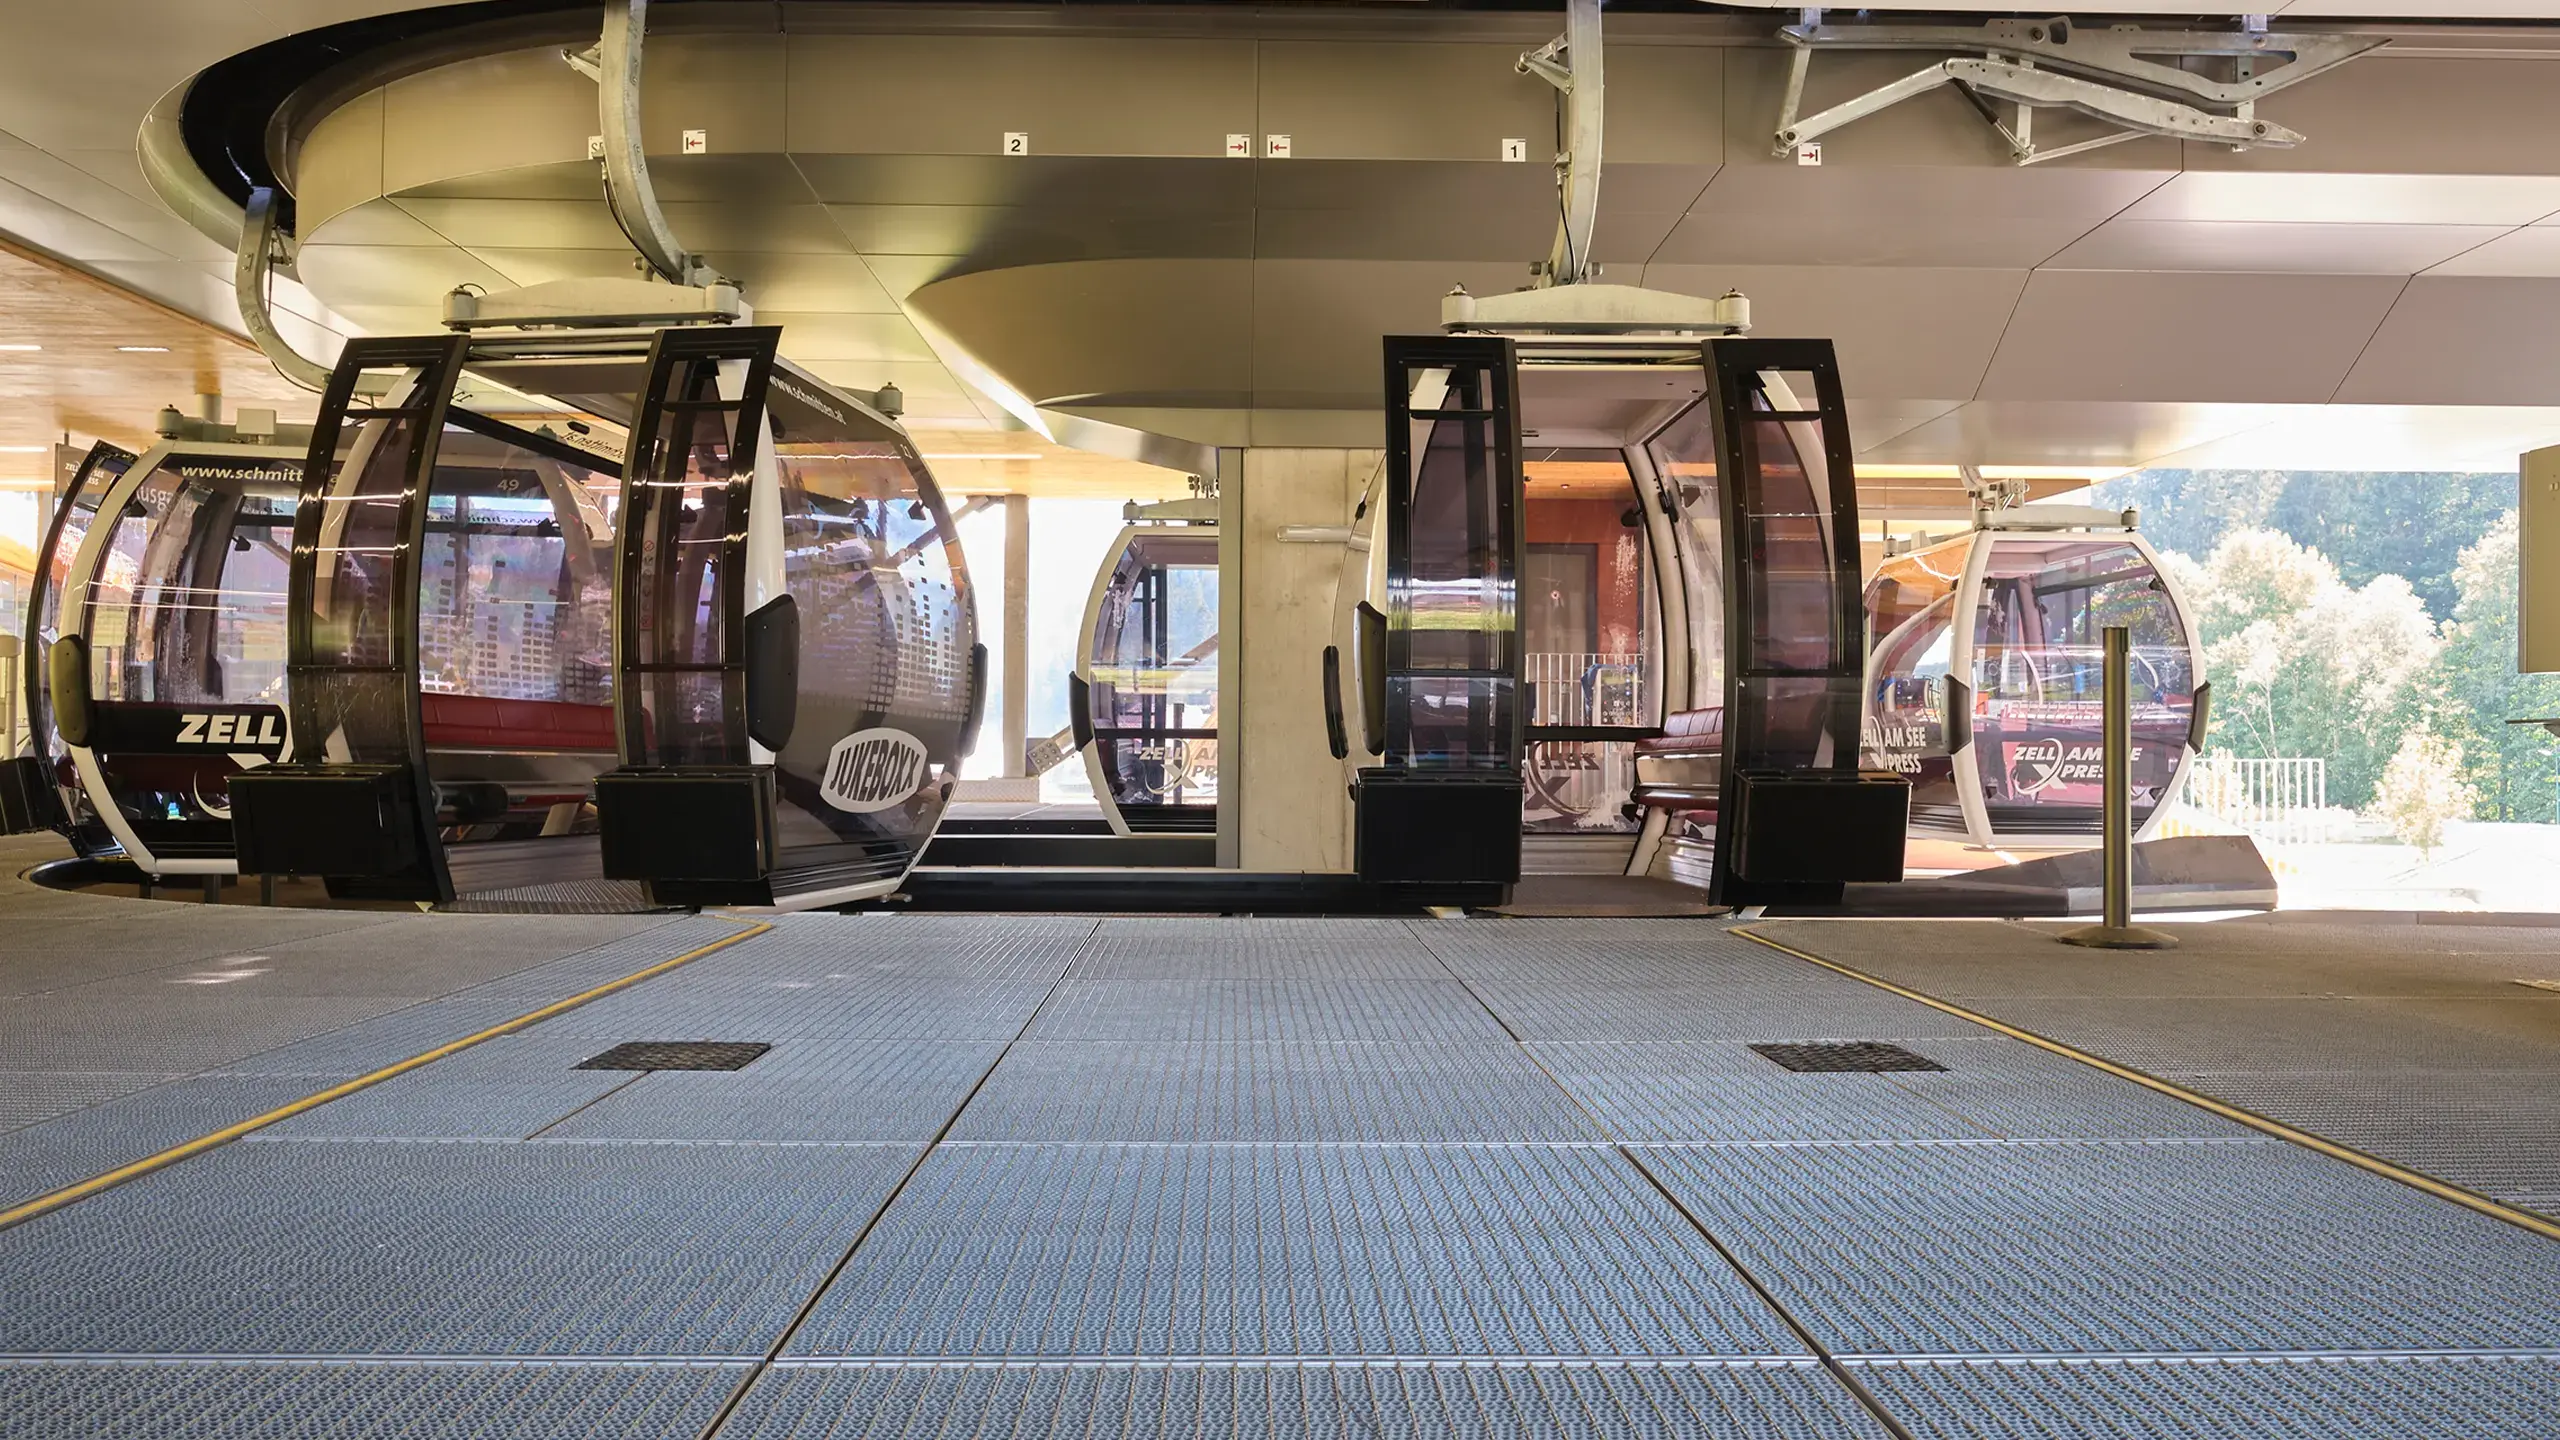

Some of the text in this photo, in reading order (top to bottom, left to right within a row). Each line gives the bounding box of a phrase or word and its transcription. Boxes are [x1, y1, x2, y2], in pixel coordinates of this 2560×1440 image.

[1011, 139, 1021, 152] 2
[1510, 145, 1517, 158] 1
[497, 479, 520, 491] 49
[176, 714, 281, 745] ZELL
[1885, 727, 1905, 747] AM
[1906, 726, 1927, 747] SEE
[1139, 746, 1183, 760] ZELL
[2013, 746, 2056, 761] ZELL
[829, 739, 921, 802] JUKEBOXX
